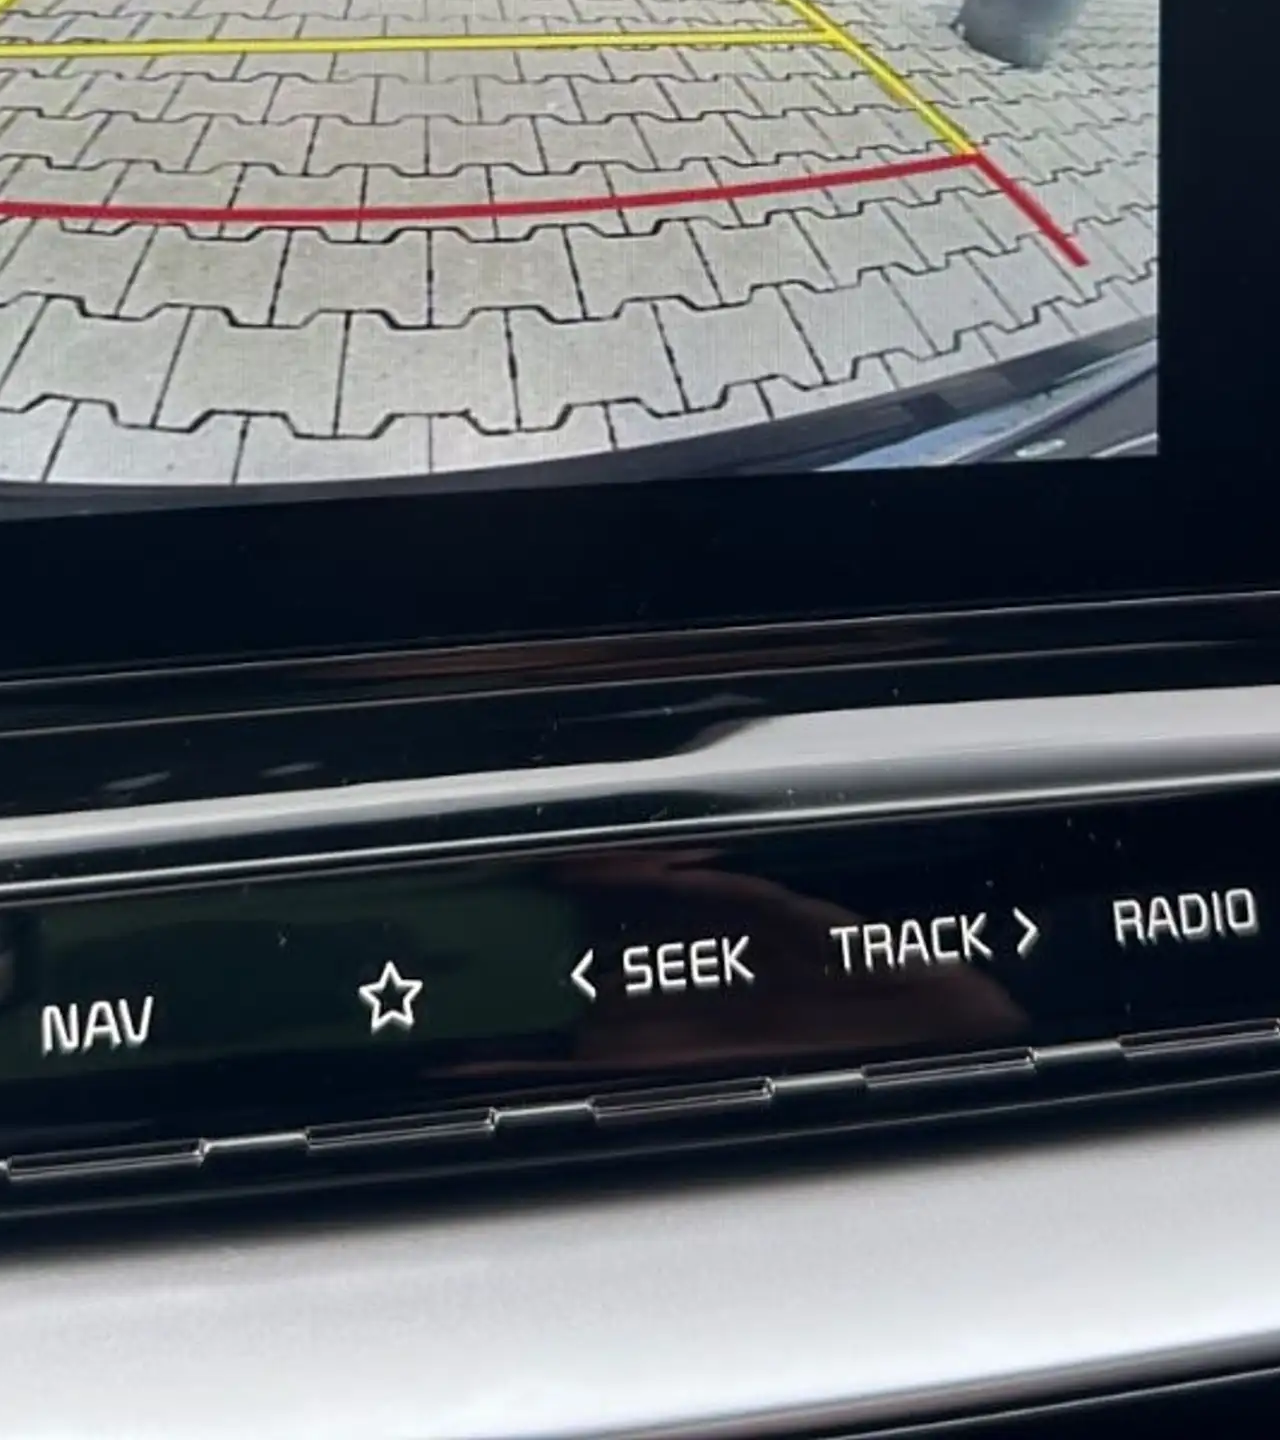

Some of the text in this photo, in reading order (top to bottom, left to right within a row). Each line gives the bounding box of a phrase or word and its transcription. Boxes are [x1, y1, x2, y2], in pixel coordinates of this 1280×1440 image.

[829, 911, 994, 974] TRACK
[1112, 887, 1259, 945] RADIO
[621, 934, 756, 995] SEEK
[40, 994, 155, 1057] NAV
